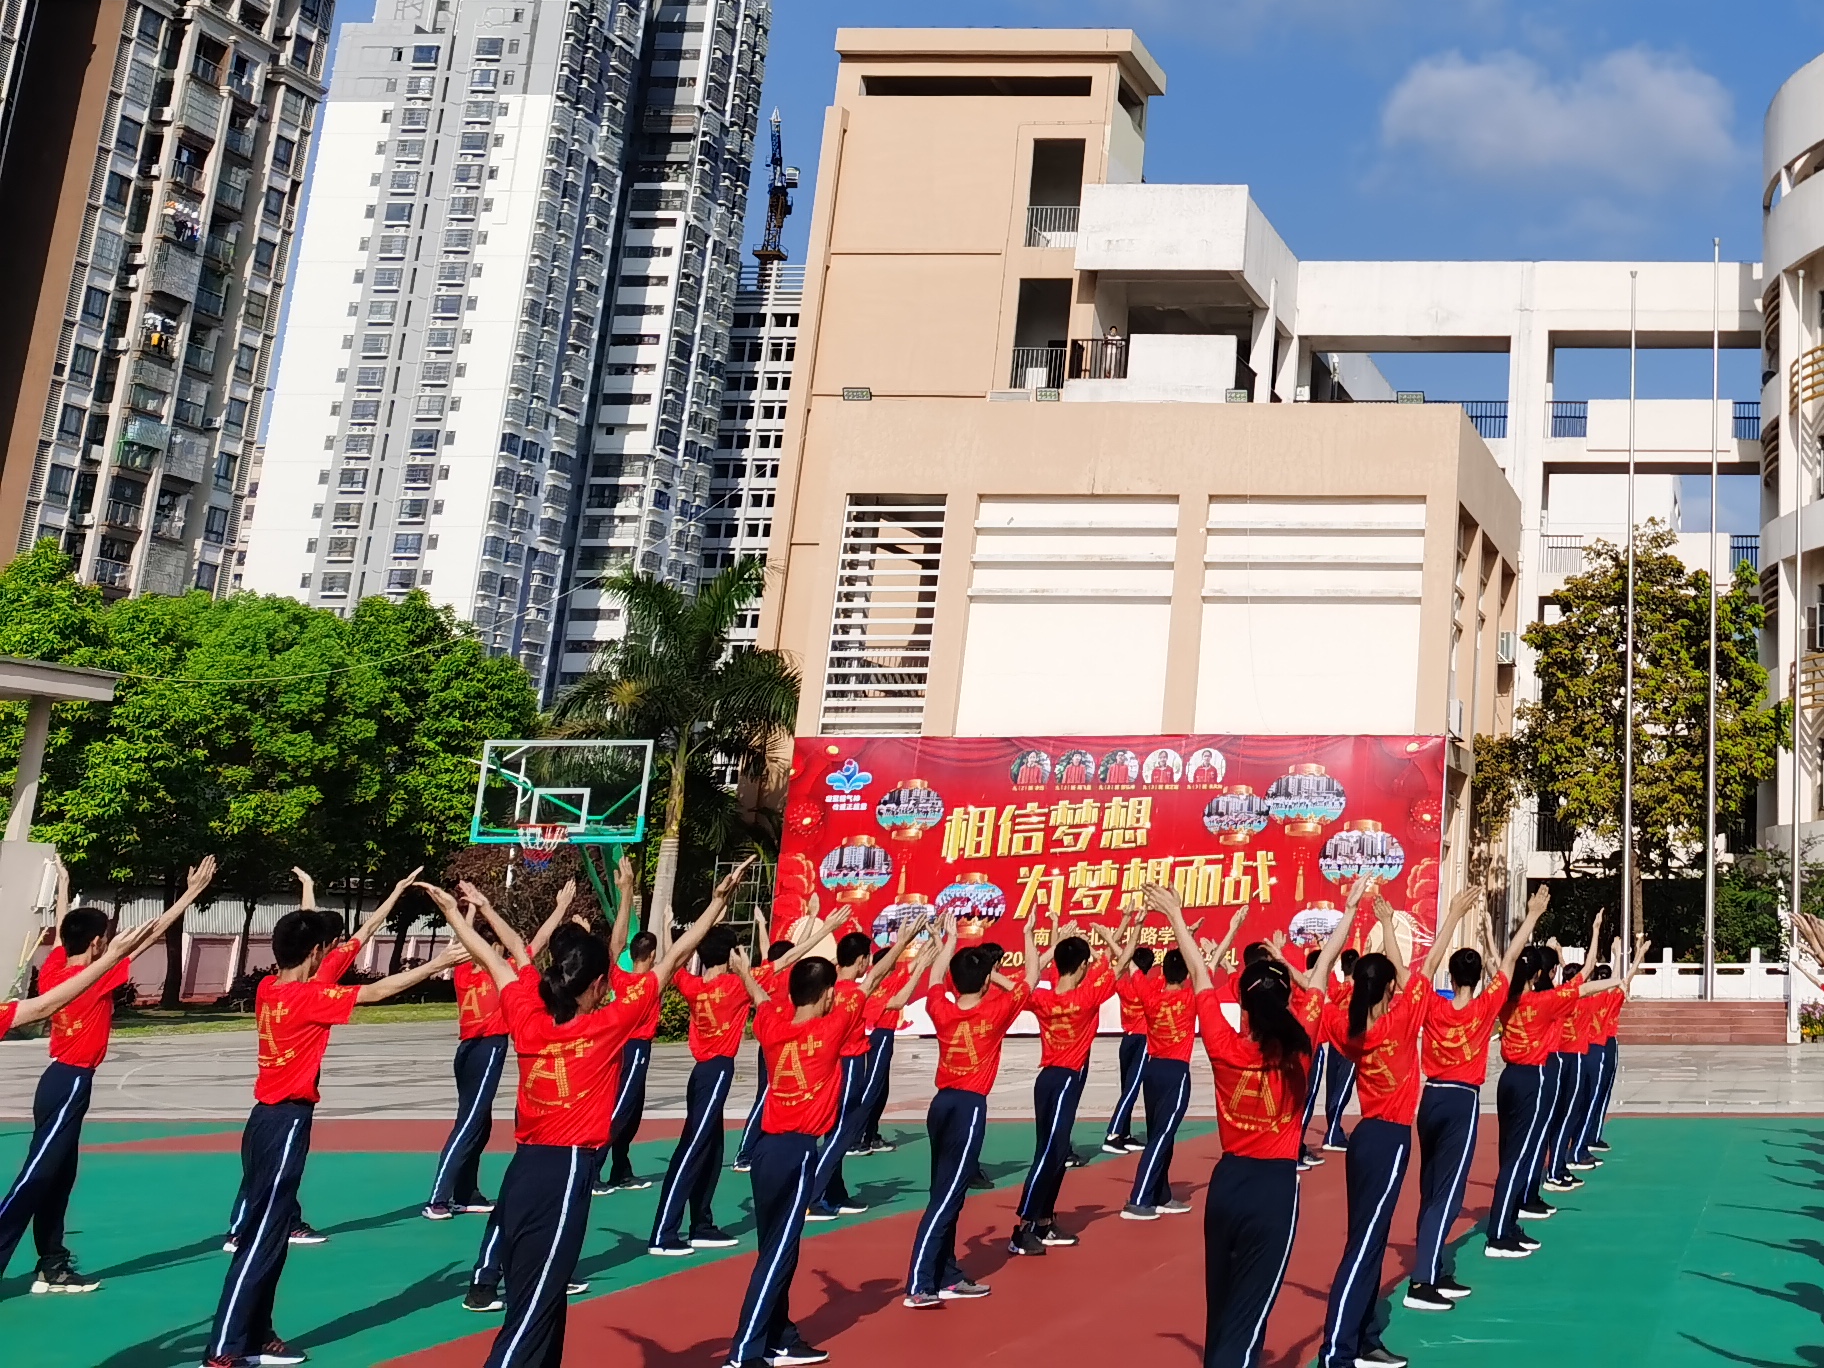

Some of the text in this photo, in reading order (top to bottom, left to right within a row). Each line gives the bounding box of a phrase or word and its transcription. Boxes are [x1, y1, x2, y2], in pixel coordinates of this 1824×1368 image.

[943, 795, 1153, 862] 相信梦想
[1013, 850, 1277, 919] 为梦想而战
[460, 982, 493, 1019] A+
[696, 987, 727, 1028] A+
[525, 1037, 594, 1098] A+
[772, 1034, 823, 1090] A+
[946, 1019, 993, 1066] A+
